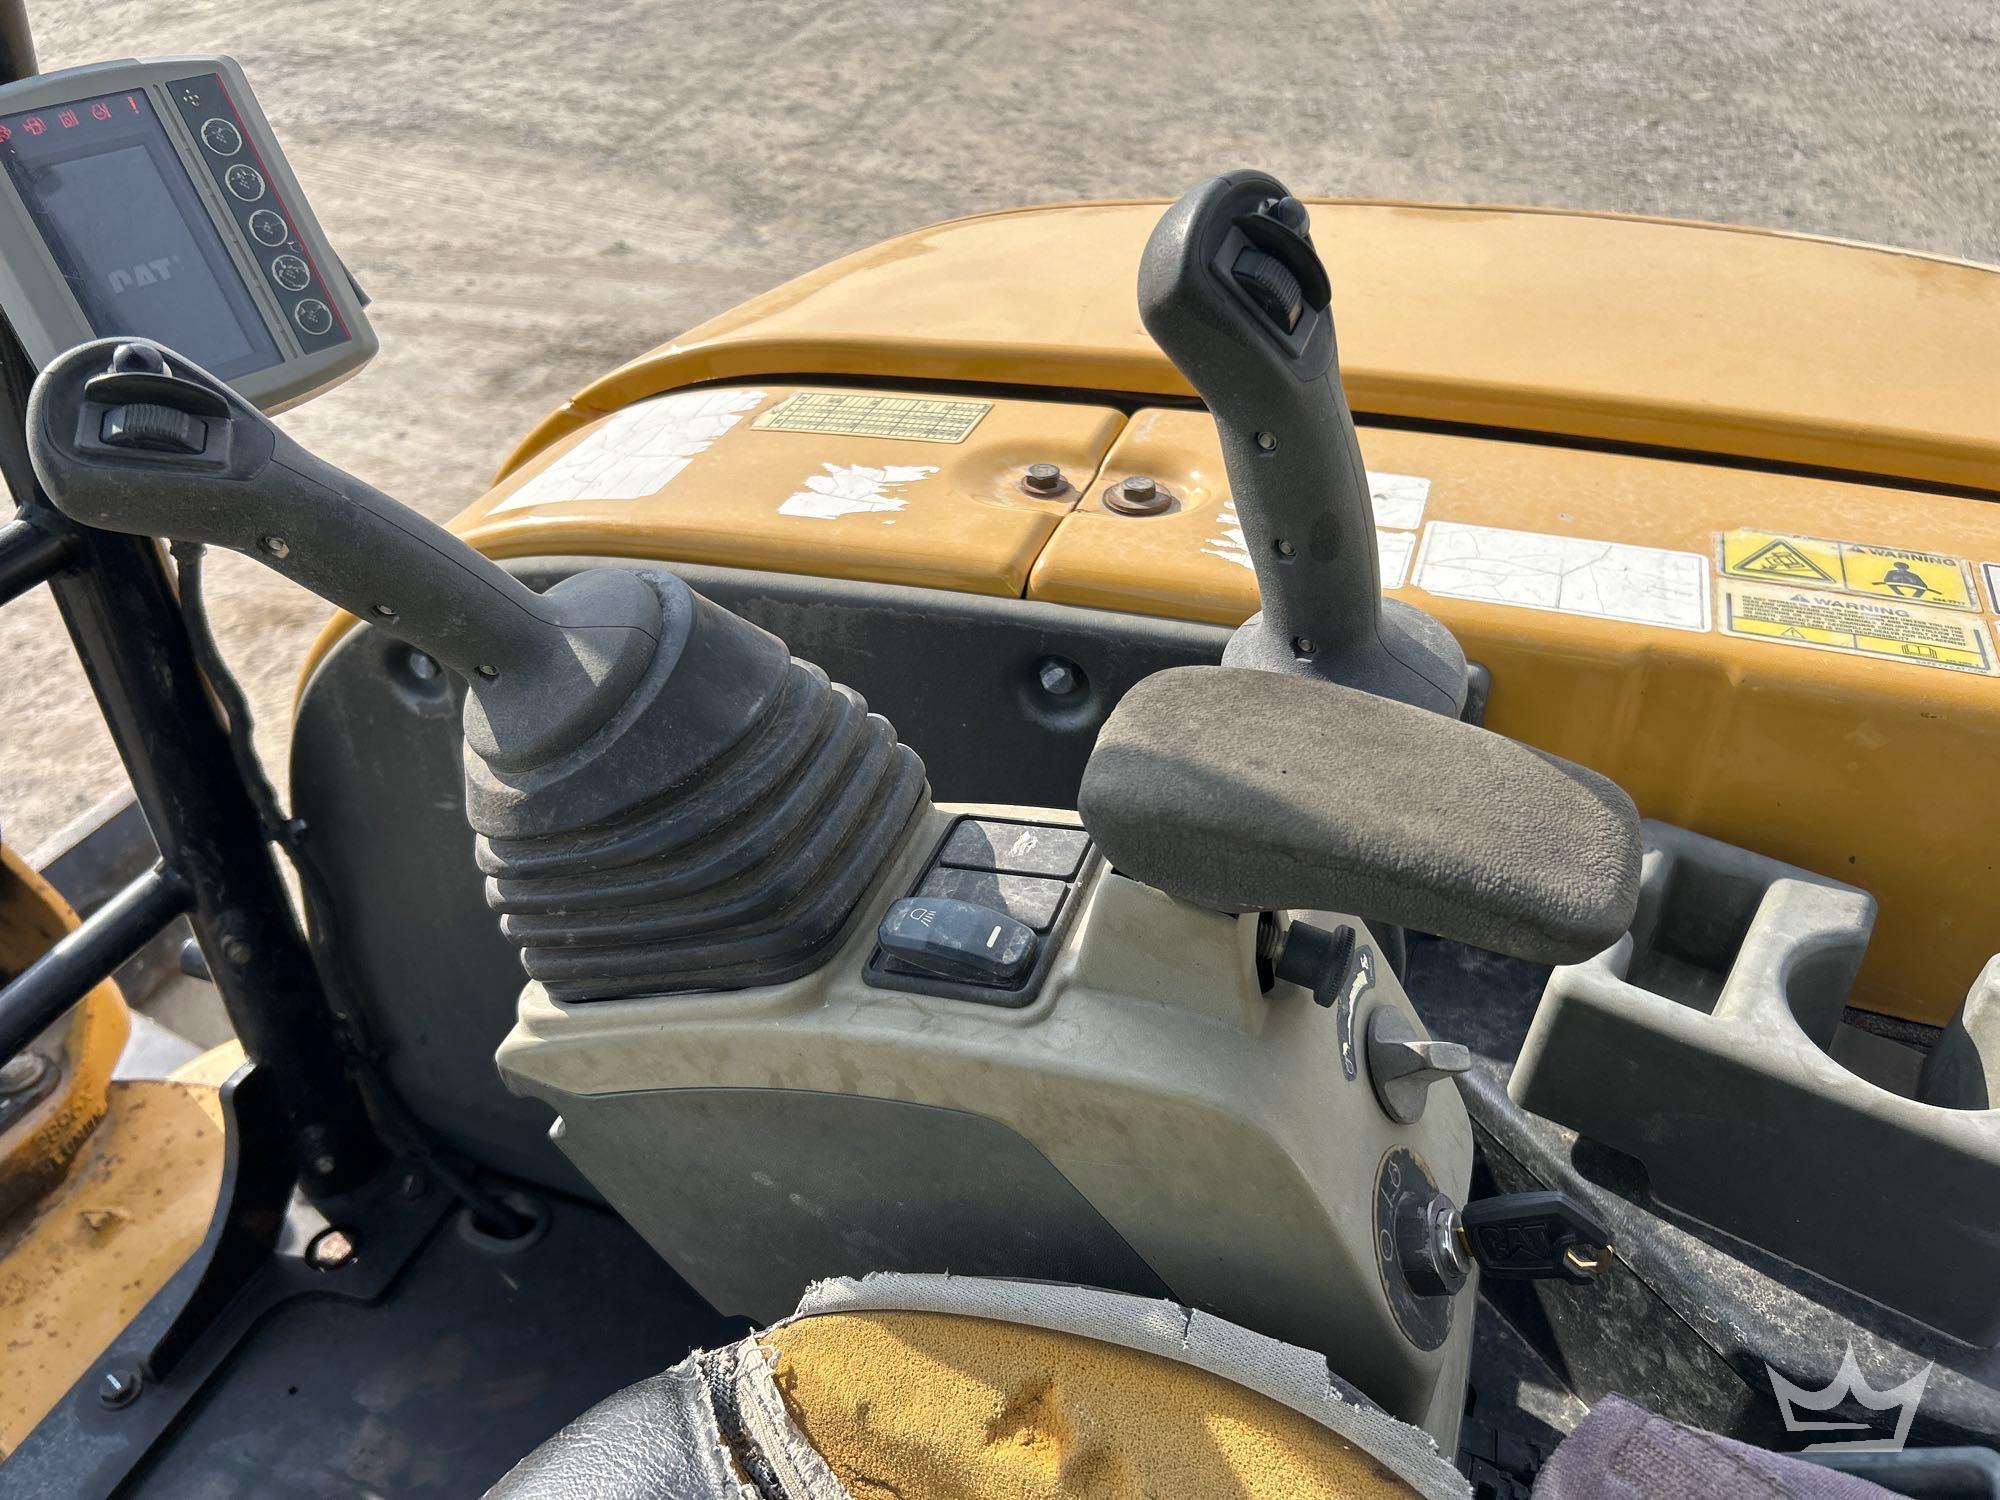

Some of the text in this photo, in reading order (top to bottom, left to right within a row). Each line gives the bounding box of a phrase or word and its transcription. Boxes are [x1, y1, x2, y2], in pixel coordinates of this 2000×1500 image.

[1868, 548, 1957, 567] WARNING
[1812, 596, 1910, 618] WARNING
[1477, 1223, 1550, 1263] CAT
